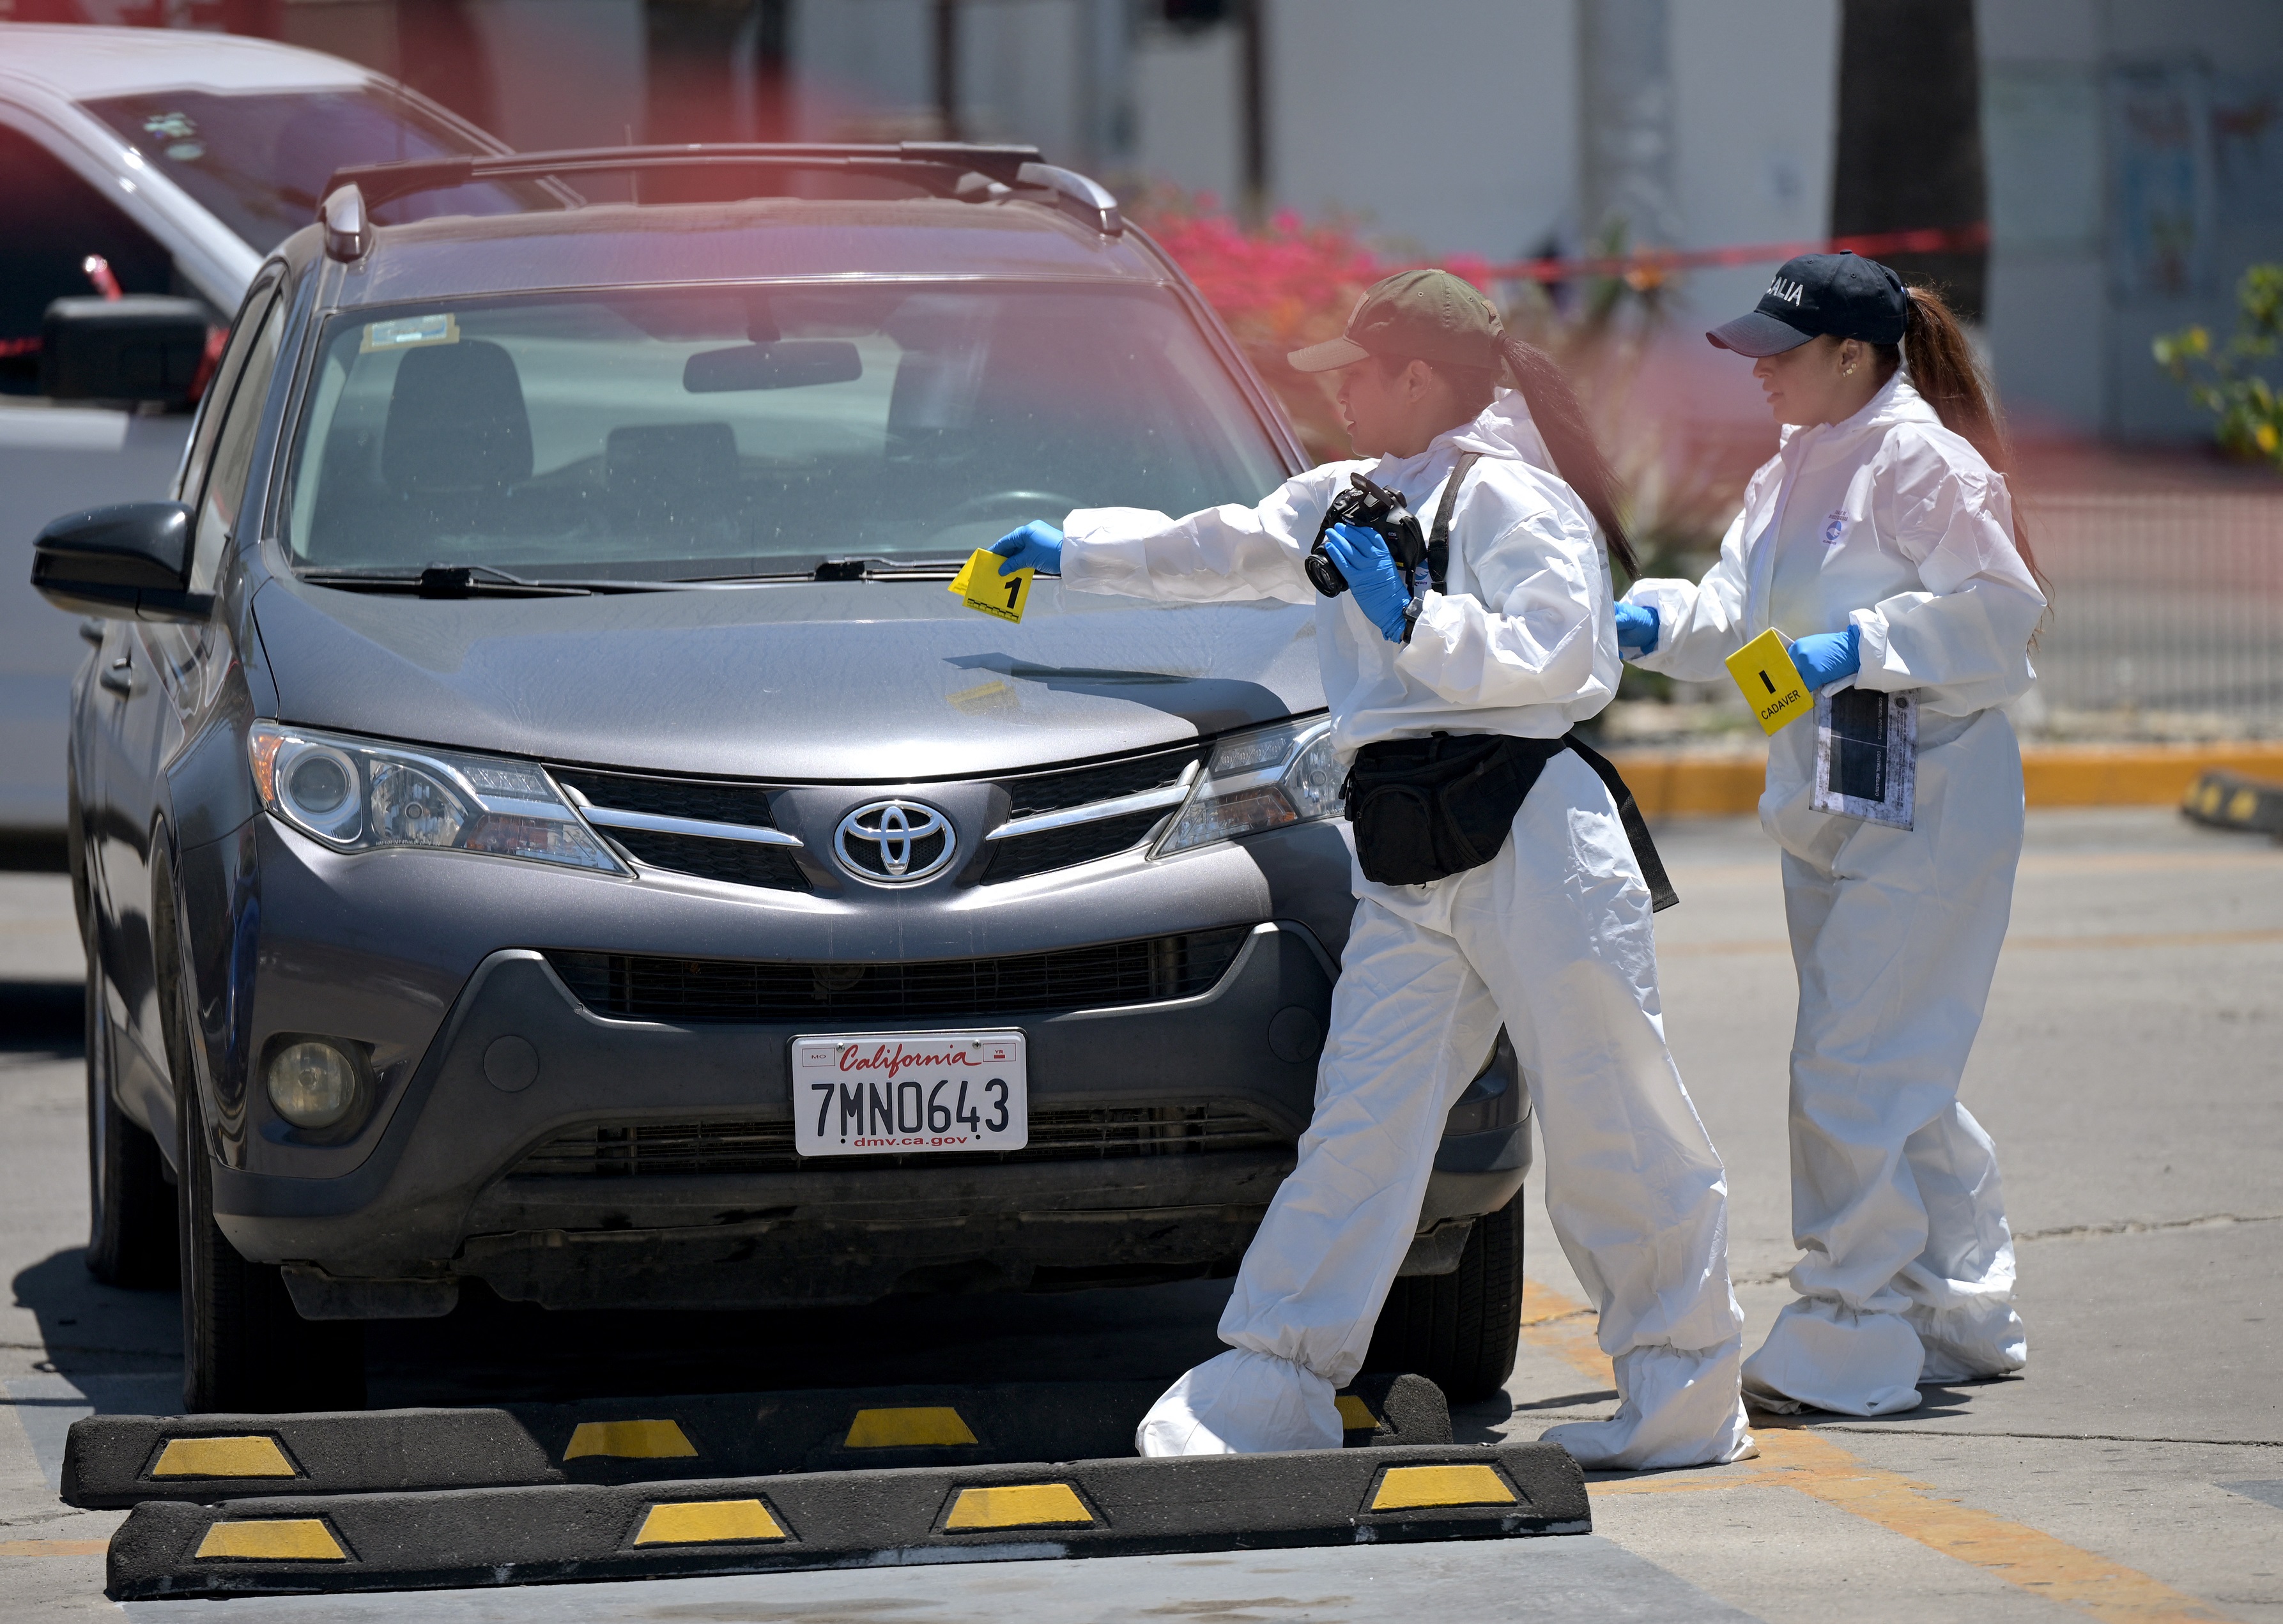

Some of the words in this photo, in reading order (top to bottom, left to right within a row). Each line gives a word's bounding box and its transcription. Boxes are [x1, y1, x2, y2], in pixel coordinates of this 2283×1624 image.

[1004, 577, 1022, 609] 1
[1761, 689, 1801, 720] CADAVER
[839, 1043, 982, 1078] California
[854, 1137, 968, 1147] dmv.ca.gov
